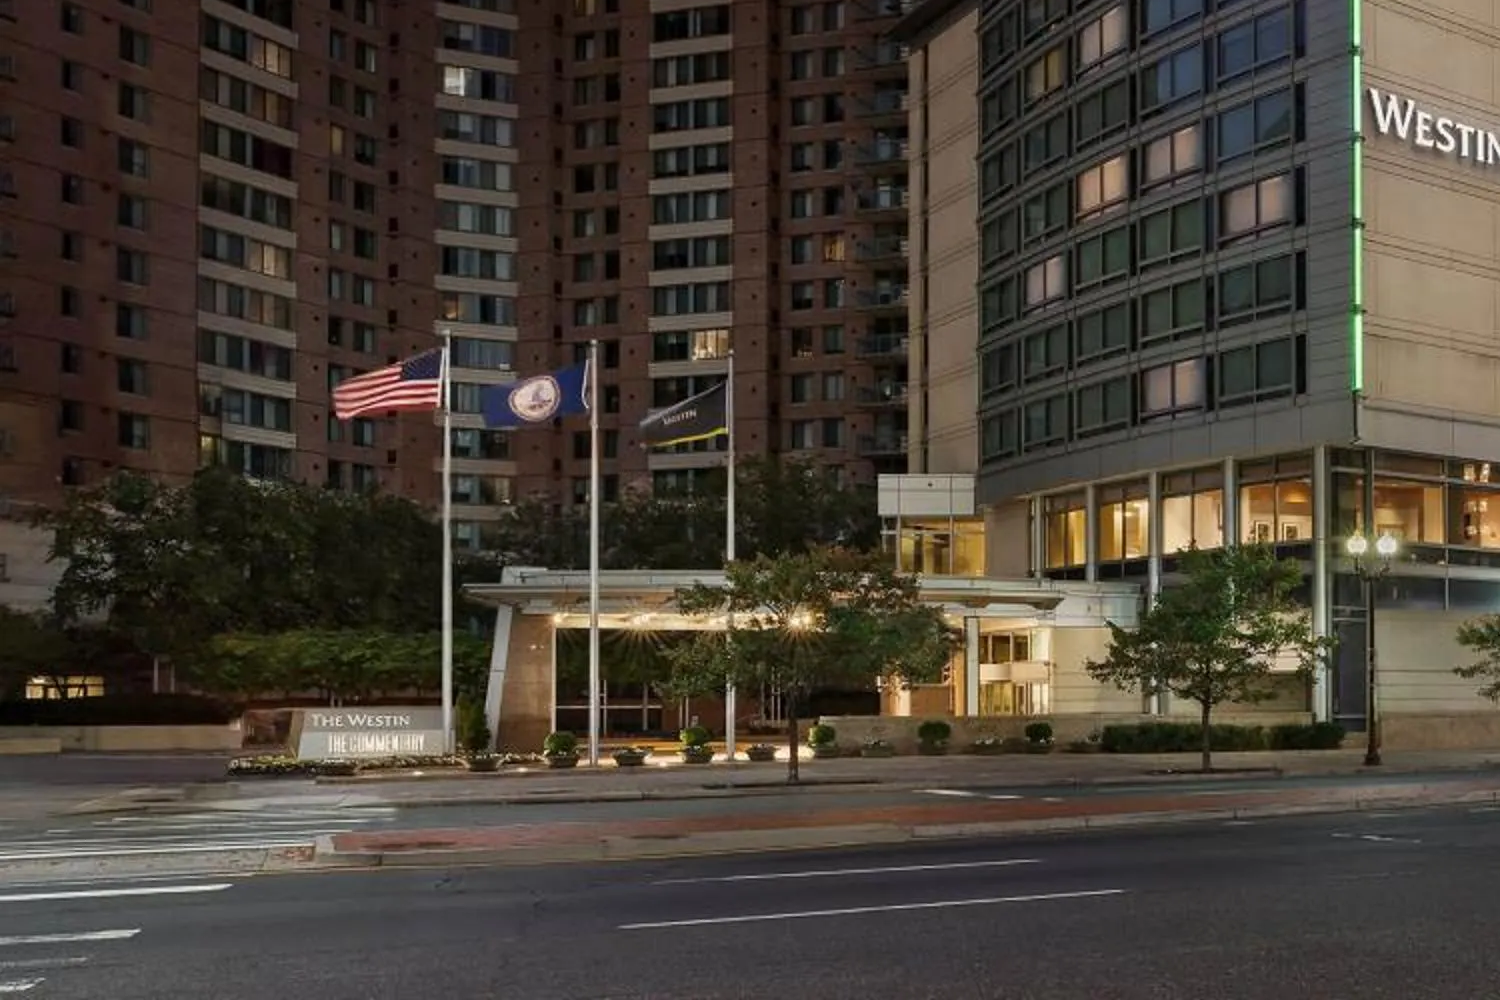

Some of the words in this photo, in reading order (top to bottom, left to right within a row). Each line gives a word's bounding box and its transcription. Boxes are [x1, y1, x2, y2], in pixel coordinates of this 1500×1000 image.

[311, 713, 344, 727] THE
[347, 713, 411, 728] WESTIN
[328, 732, 347, 753] THE
